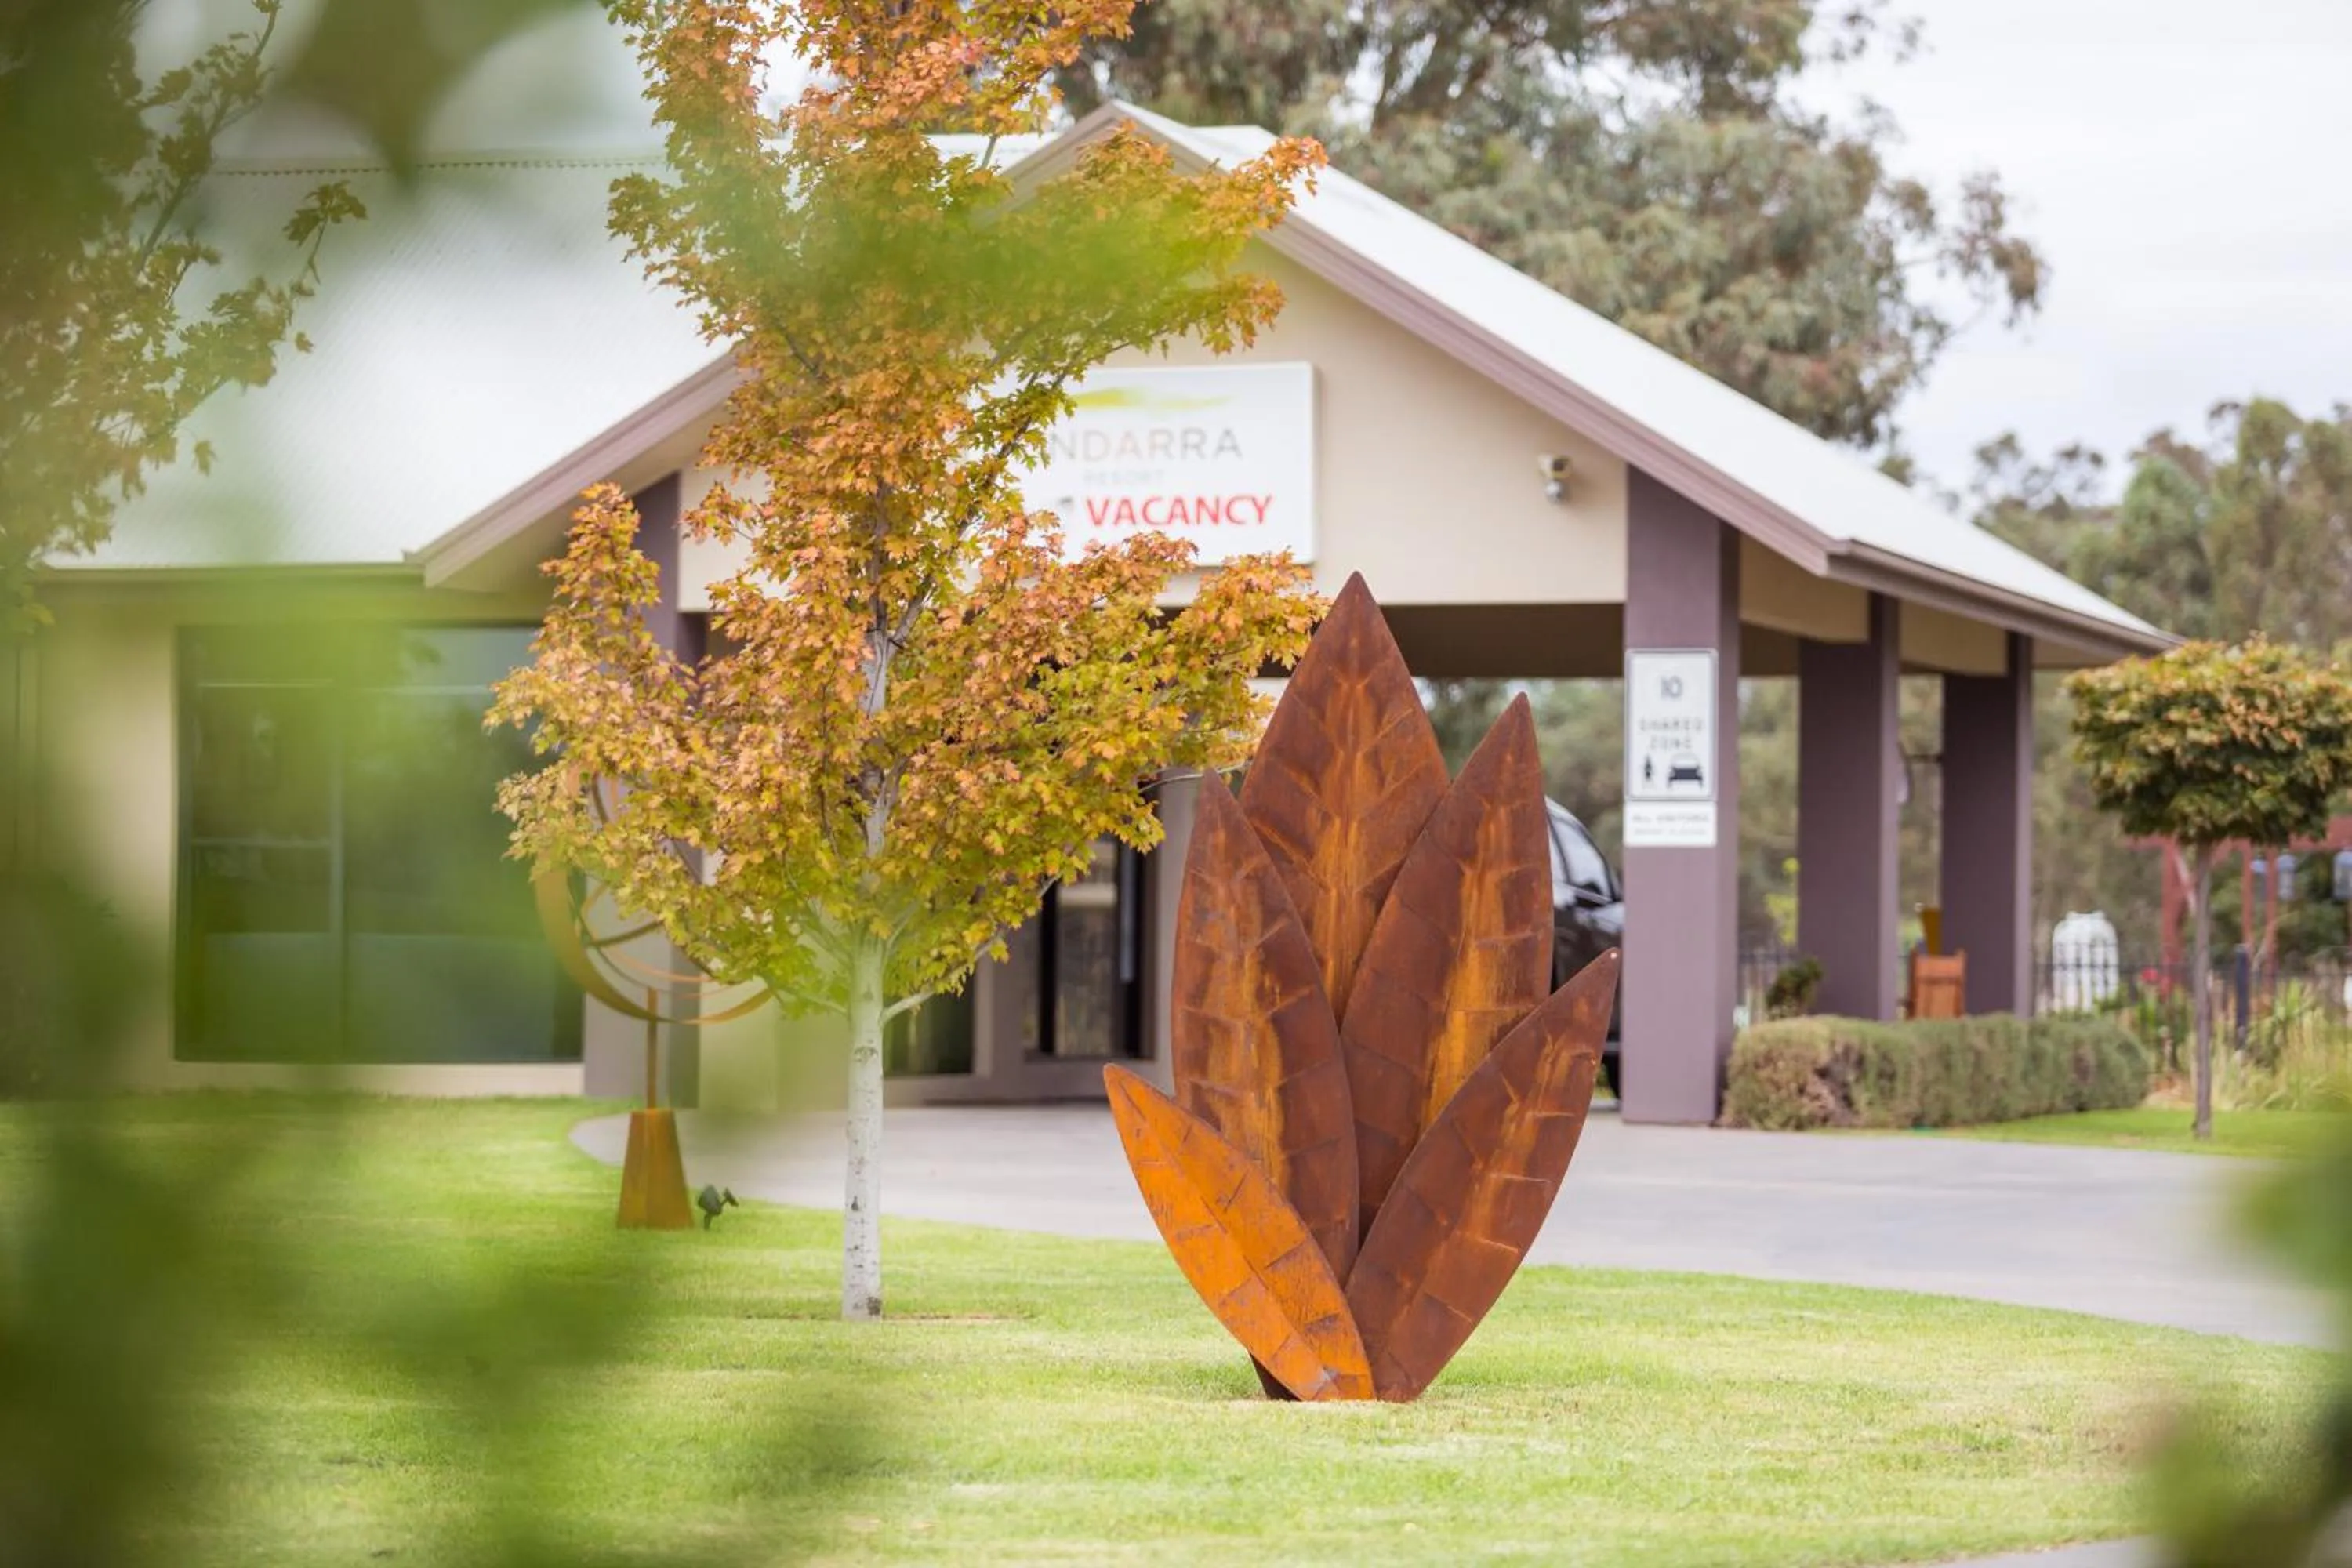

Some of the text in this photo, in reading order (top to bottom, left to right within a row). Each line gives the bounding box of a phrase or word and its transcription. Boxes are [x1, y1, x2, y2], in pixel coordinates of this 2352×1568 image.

[1051, 427, 1243, 462] NDARRA
[1085, 495, 1273, 527] VACANCY
[1661, 676, 1683, 699] 10
